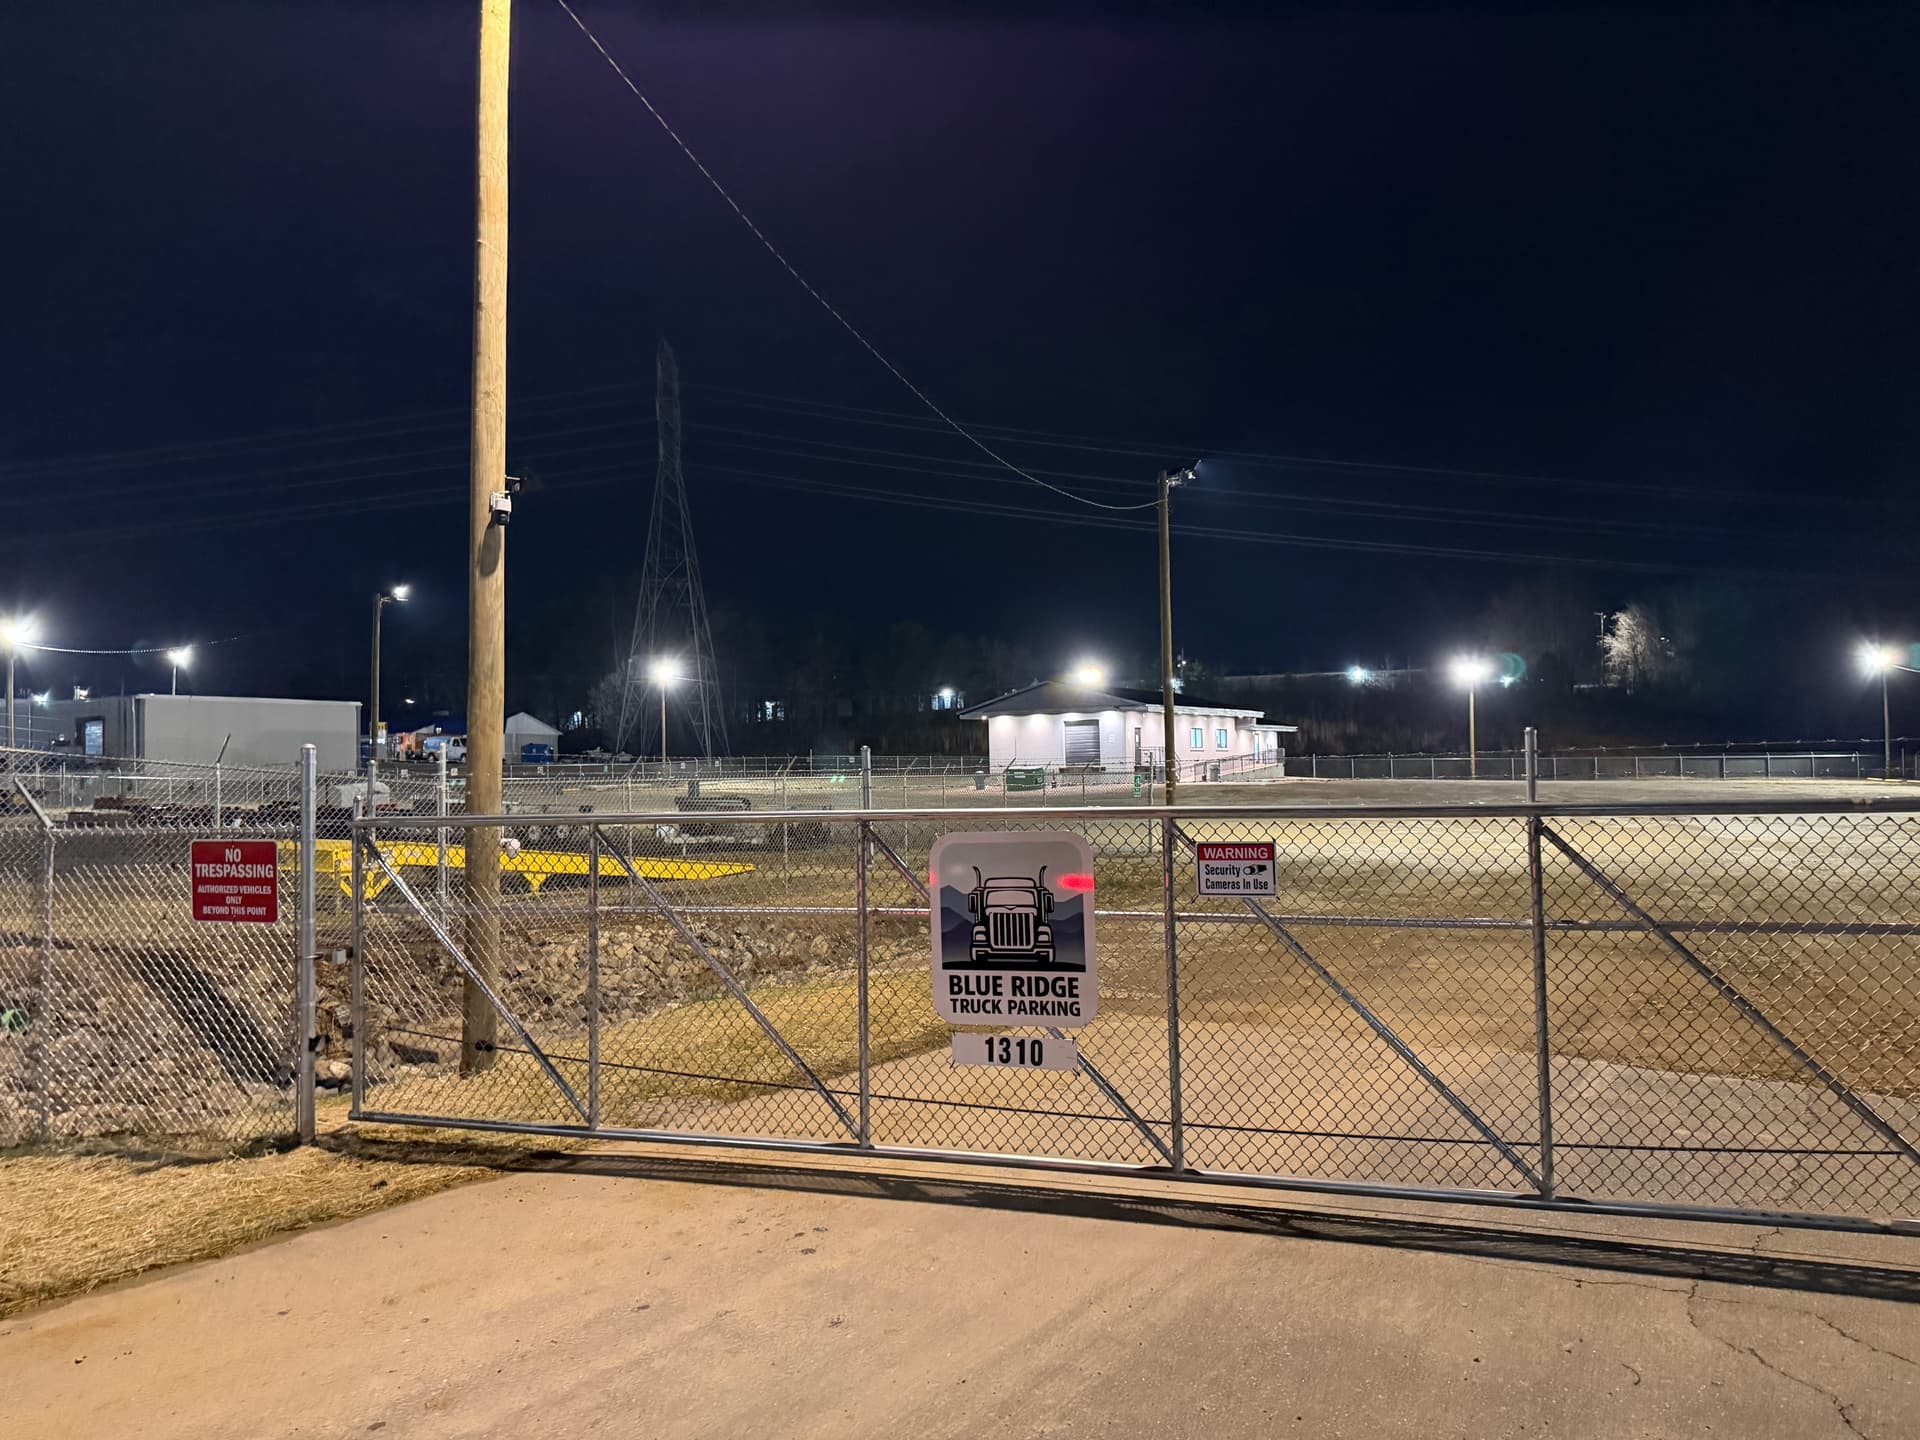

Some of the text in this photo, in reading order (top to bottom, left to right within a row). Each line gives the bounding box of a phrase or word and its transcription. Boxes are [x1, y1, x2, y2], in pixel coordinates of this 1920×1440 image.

[225, 848, 241, 862] NO
[1203, 847, 1268, 859] WARNING
[195, 864, 274, 878] TRESPASSING
[1205, 864, 1240, 877] Security
[197, 885, 272, 894] AUTHORIZED VEHICLES
[1205, 878, 1269, 890] Cameras In Use
[226, 896, 242, 904] ONLY
[203, 906, 266, 916] BEYOND THIS POINT
[949, 975, 1080, 999] BLUE RIDGE
[950, 998, 1081, 1017] TRUCK PARKING
[984, 1036, 1044, 1067] 1310
